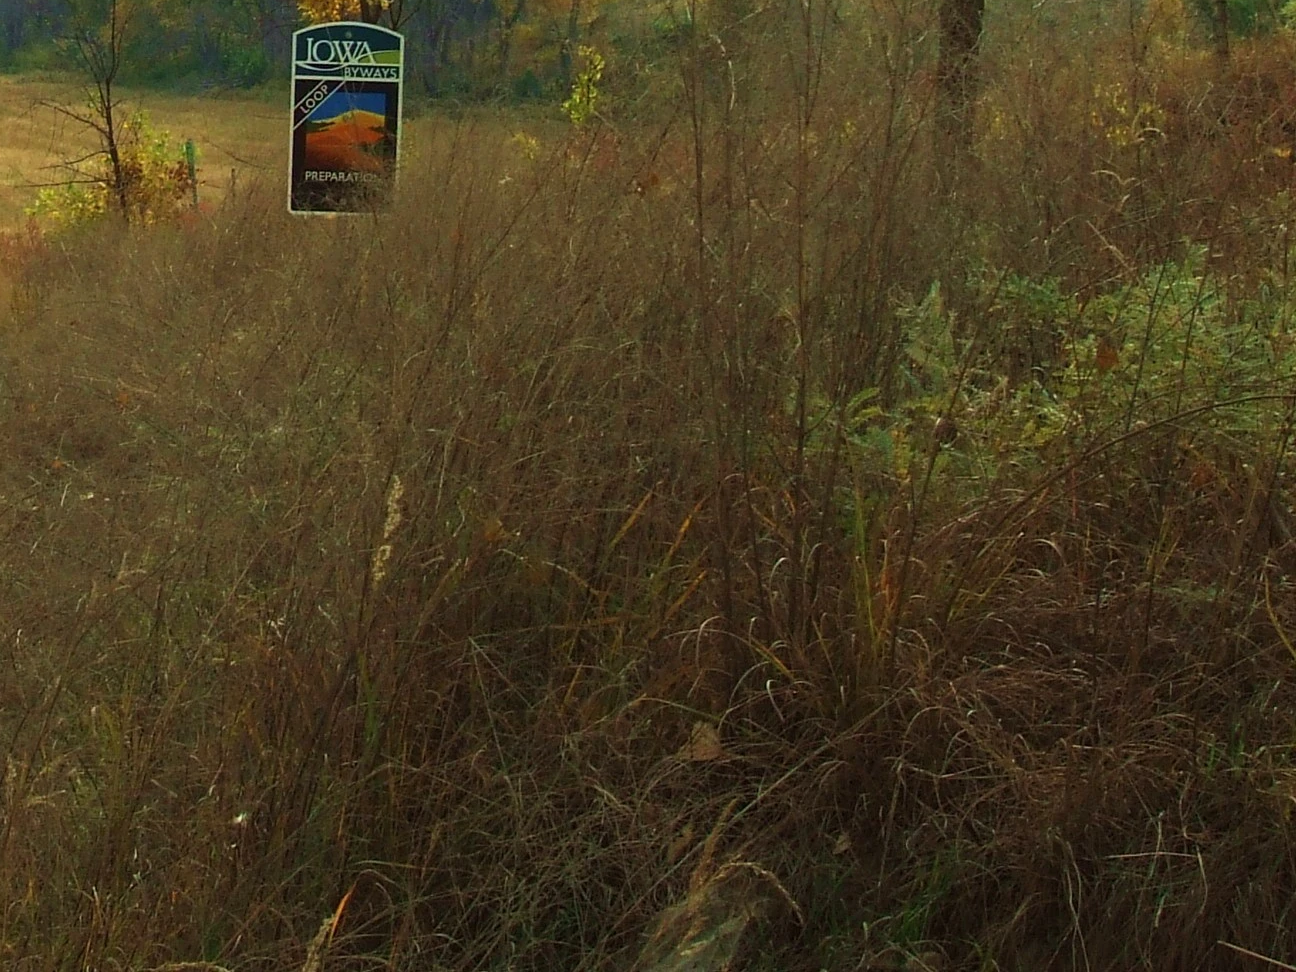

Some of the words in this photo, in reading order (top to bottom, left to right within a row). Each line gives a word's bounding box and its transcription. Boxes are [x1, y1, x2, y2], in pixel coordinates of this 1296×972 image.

[306, 38, 376, 64] IOWA
[344, 67, 397, 79] BYWAYS
[300, 84, 328, 114] LOOP
